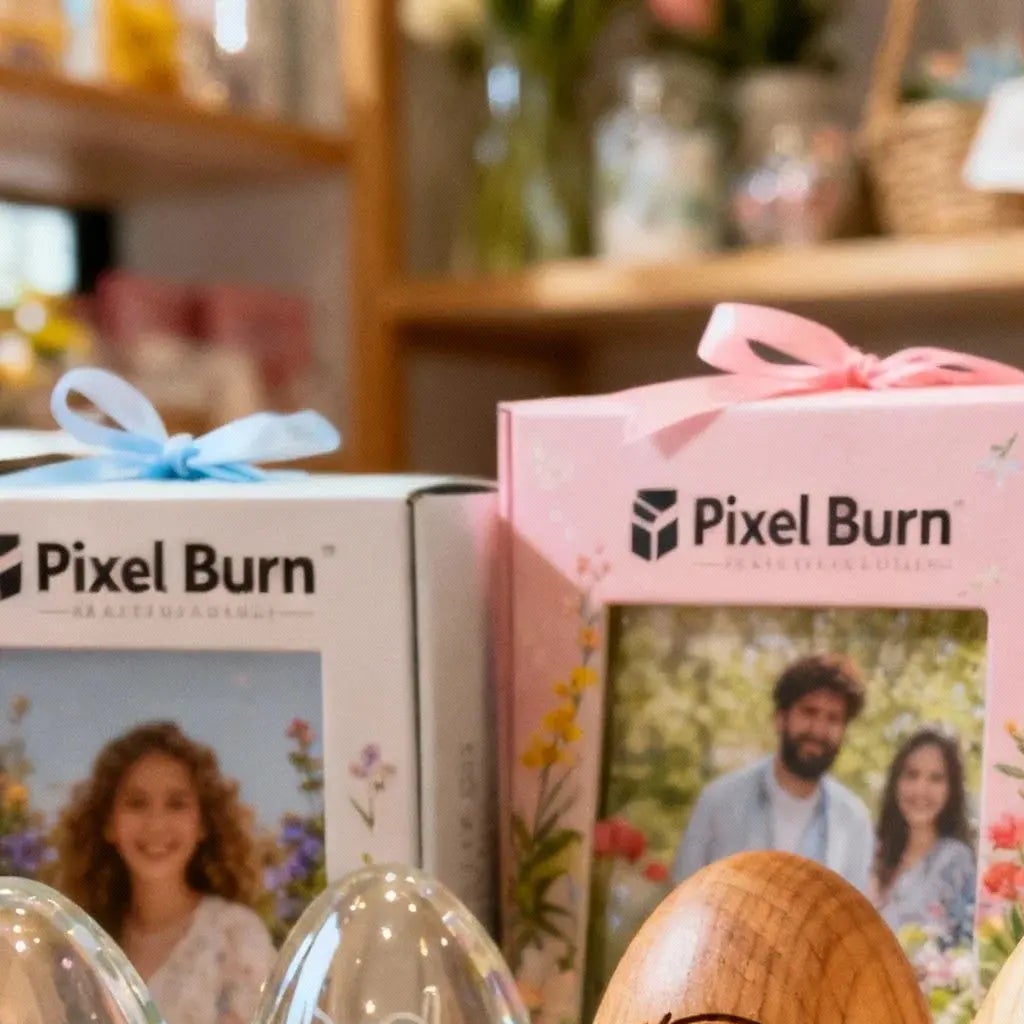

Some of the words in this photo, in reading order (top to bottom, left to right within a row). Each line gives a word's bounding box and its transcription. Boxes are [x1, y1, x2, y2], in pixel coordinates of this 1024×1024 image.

[694, 493, 810, 546] Pixel
[827, 495, 951, 547] Burn
[37, 540, 167, 594] Pixel
[184, 542, 315, 595] Burn
